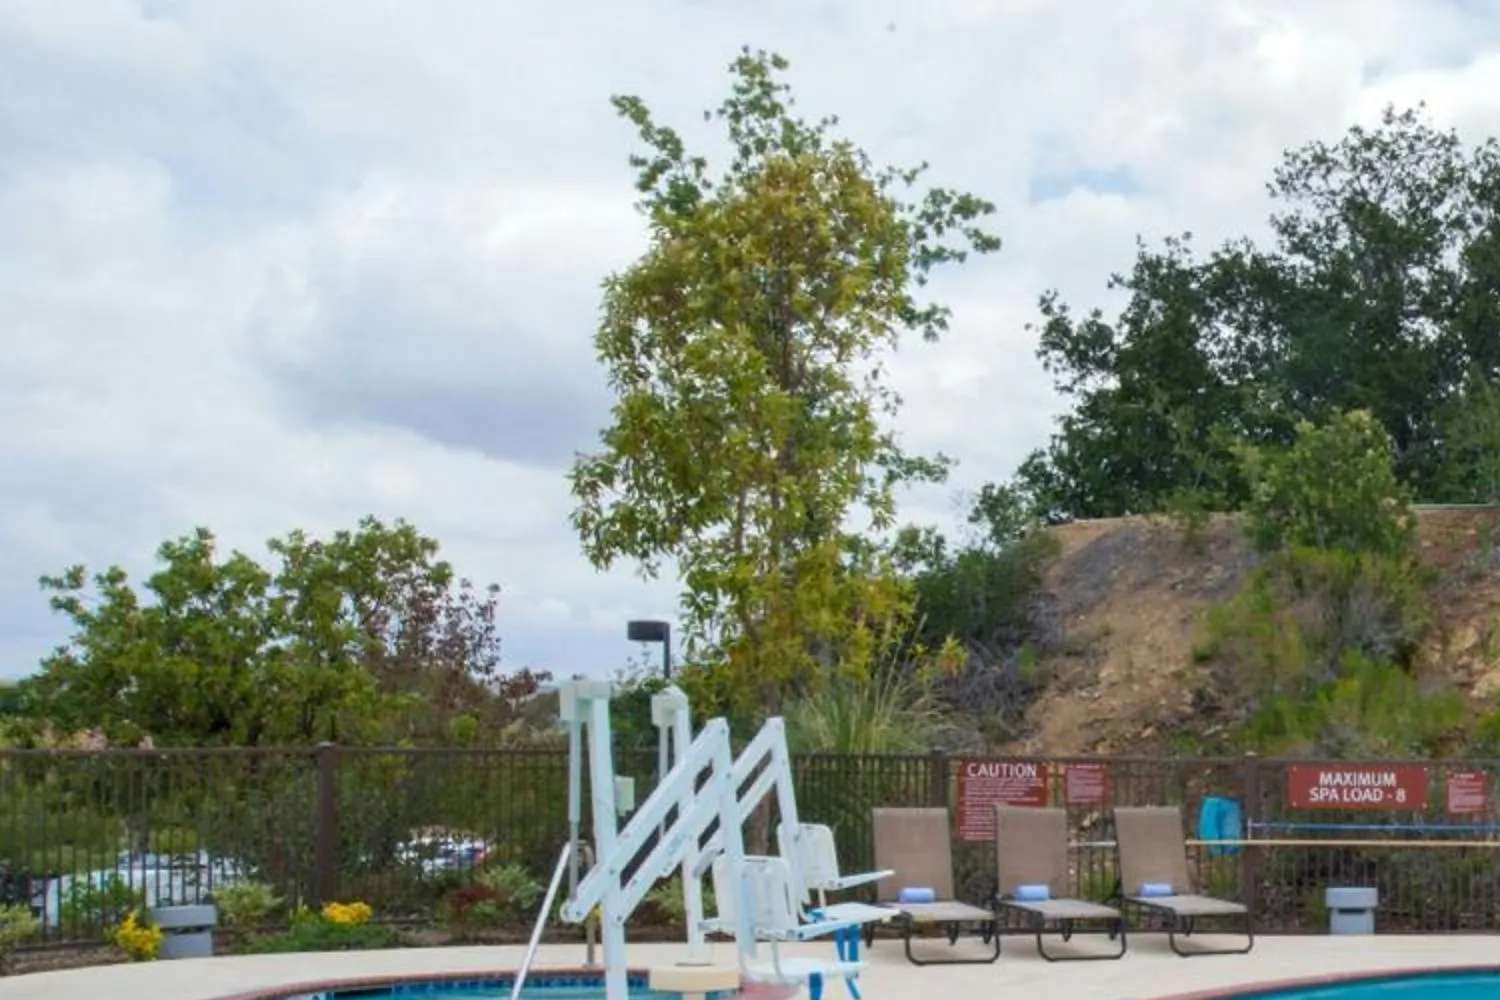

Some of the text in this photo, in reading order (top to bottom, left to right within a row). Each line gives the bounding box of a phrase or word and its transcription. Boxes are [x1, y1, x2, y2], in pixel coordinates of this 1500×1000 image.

[967, 763, 1037, 777] CAUTION
[1319, 772, 1397, 787] MAXIMUM
[1309, 787, 1339, 802] SPA
[1343, 787, 1384, 802] LOAD
[1395, 787, 1407, 803] 8
